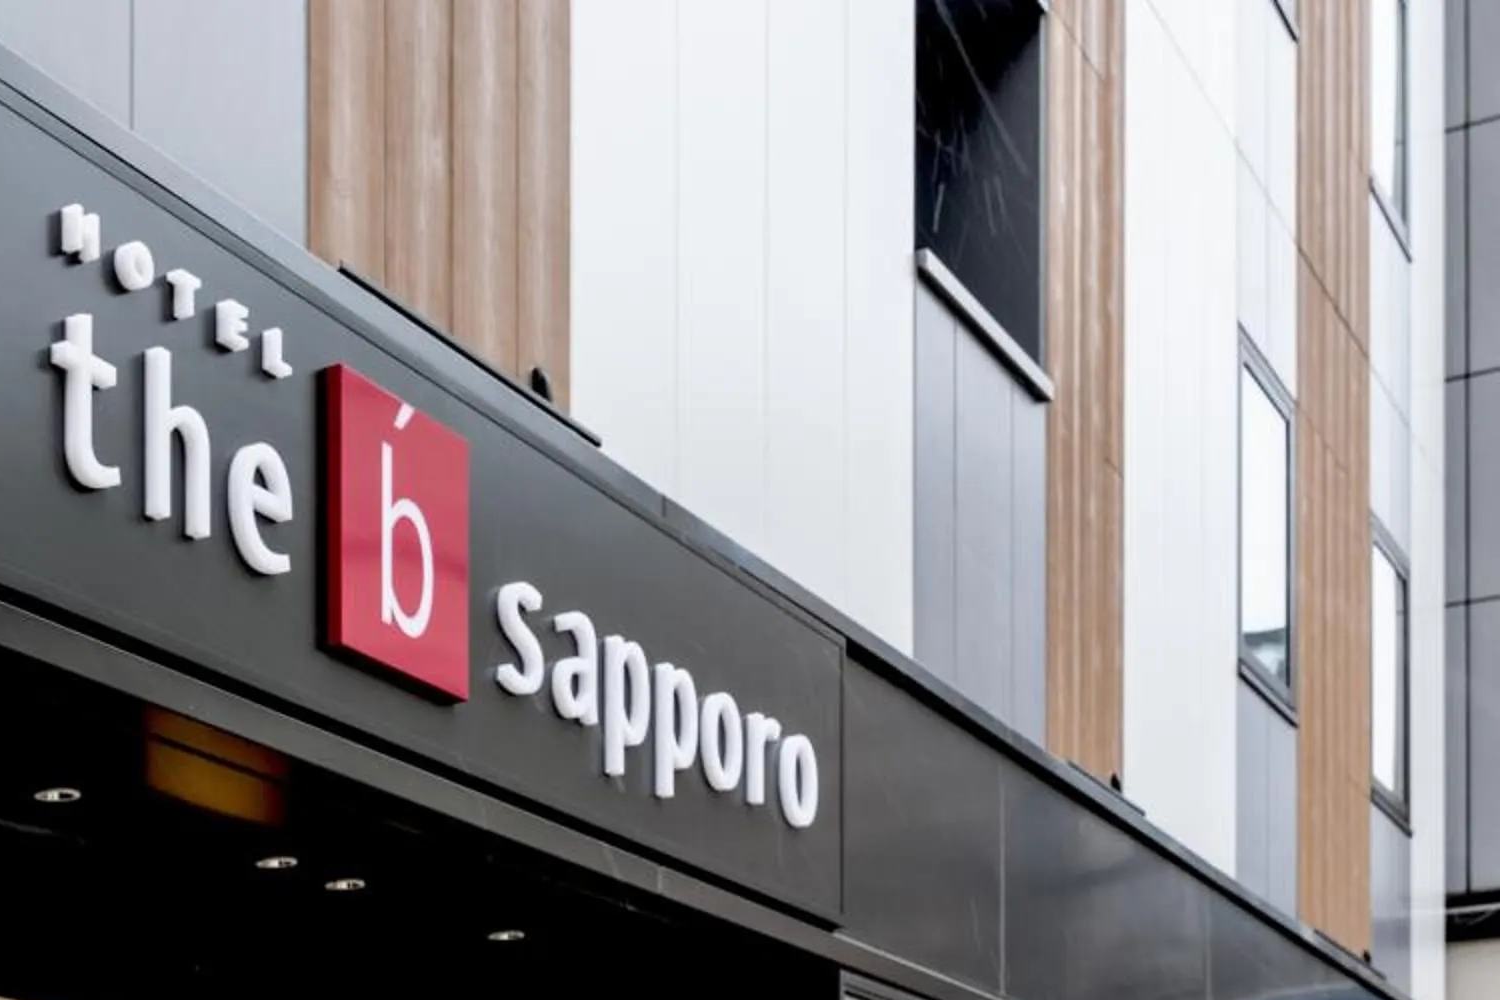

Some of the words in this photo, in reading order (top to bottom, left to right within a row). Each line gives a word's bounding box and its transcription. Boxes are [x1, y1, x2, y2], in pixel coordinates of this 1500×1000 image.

[59, 201, 293, 380] HOTEL
[50, 312, 294, 576] the
[496, 580, 820, 829] sapporo
